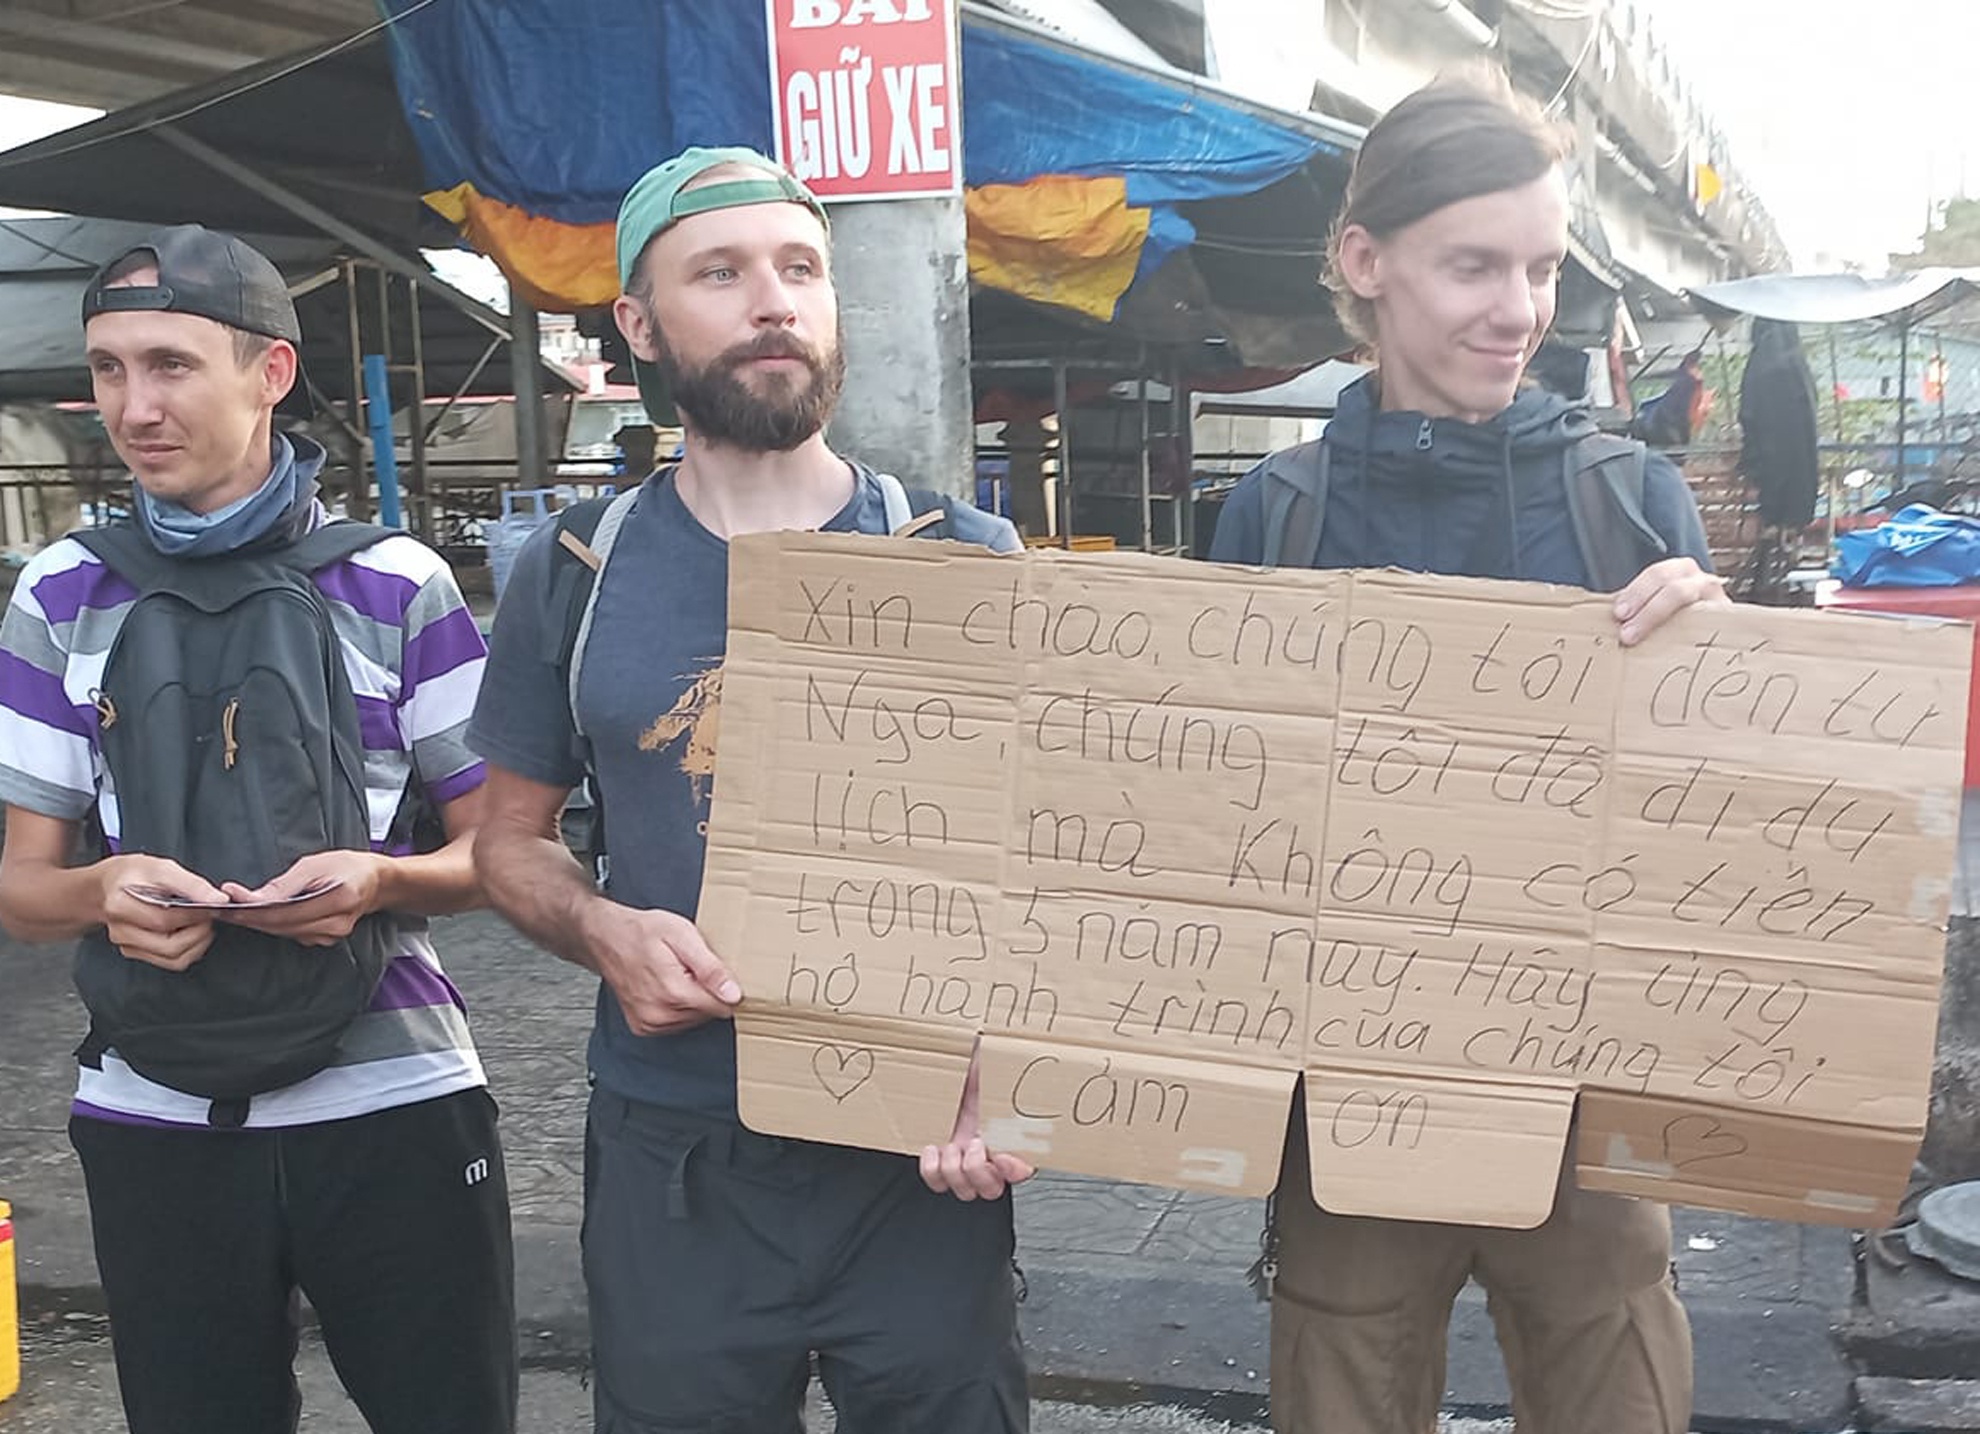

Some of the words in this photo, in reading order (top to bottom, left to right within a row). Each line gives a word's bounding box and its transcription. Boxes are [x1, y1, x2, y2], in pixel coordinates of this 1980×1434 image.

[786, 46, 872, 180] GIỮ
[882, 64, 949, 175] XE
[800, 577, 913, 647] Xin
[1188, 591, 1432, 712] chúng
[1472, 622, 1605, 704] tôi
[1650, 630, 1800, 734] đến
[806, 669, 1006, 764] Nga,
[1036, 683, 1268, 810] chúng
[1335, 718, 1460, 795] tôi
[1762, 778, 1894, 863] du
[1028, 791, 1161, 877] mà
[1522, 853, 1638, 913] có
[787, 872, 988, 963] trong
[1009, 886, 1048, 955] 5
[1076, 901, 1223, 970] năm
[1011, 1055, 1190, 1133] Cảm
[1108, 979, 1295, 1050] trình
[1462, 1017, 1661, 1095] chúng
[1692, 1042, 1827, 1104] tôi
